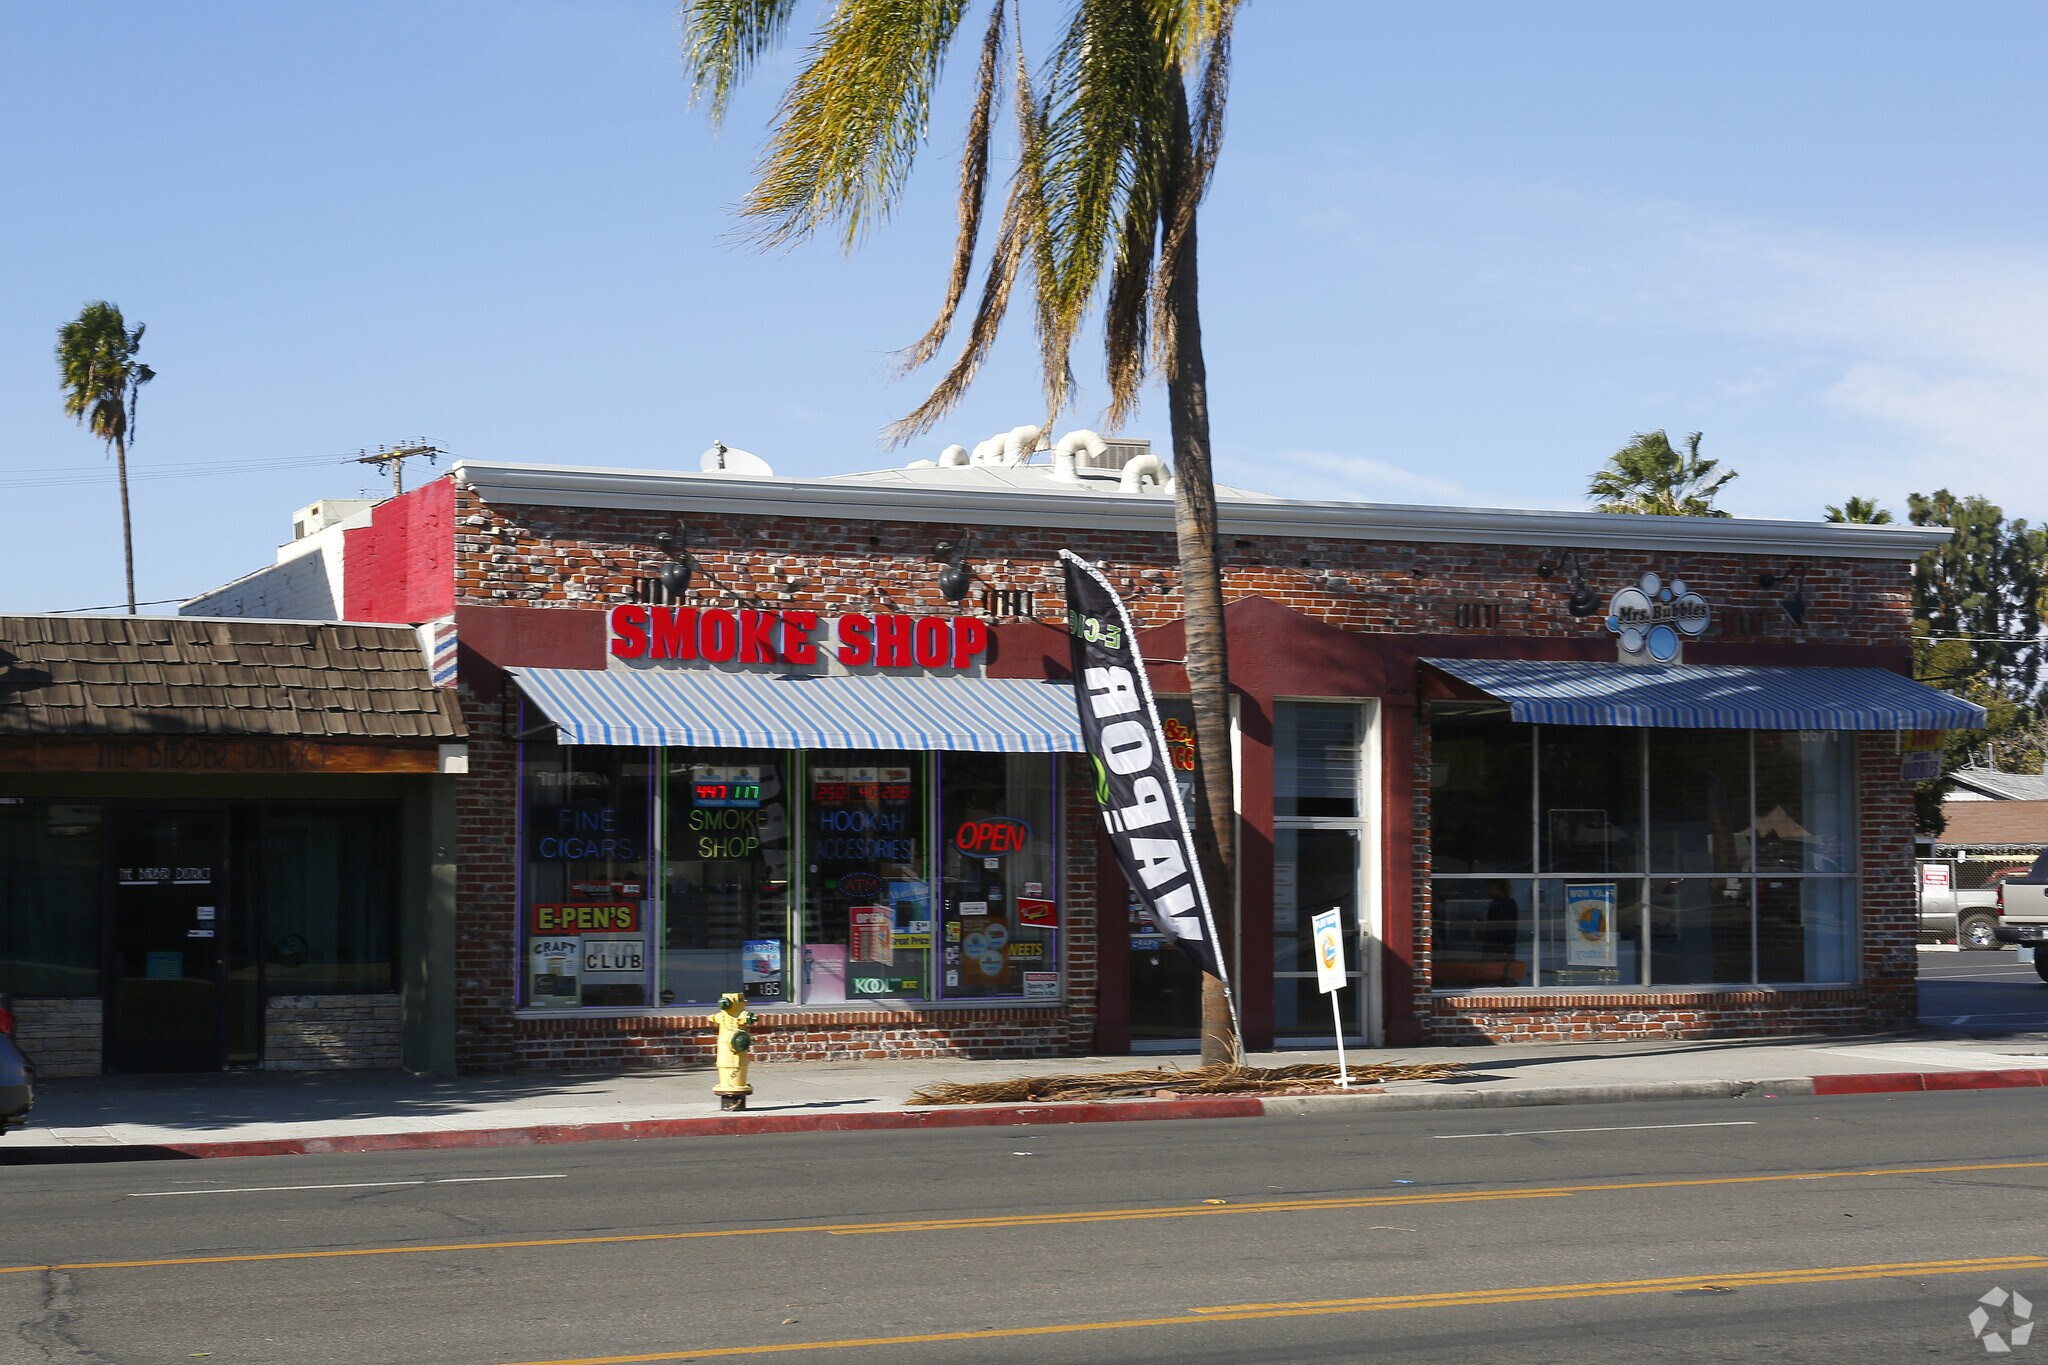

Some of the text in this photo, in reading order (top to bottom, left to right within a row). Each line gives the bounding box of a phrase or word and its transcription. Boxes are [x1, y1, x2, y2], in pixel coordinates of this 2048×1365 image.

[1619, 601, 1707, 622] Mrs. Bubbles
[609, 605, 988, 669] SMOKE SHOP
[97, 741, 329, 770] THE BARBER DISTRICT
[695, 785, 727, 799] 447
[558, 808, 616, 832] FINE
[688, 809, 769, 830] SMOKE
[820, 810, 905, 832] HOOKAH
[698, 836, 760, 858] SHOP
[956, 821, 1026, 852] OPEN
[540, 836, 634, 859] CIGARS
[119, 867, 212, 881] THE BARBER DISTRICT
[846, 879, 878, 893] ATM
[537, 906, 632, 930] E-PEN'S
[856, 913, 884, 924] OPEN
[534, 941, 577, 955] CRAFT
[892, 937, 910, 945] reat
[587, 955, 641, 969] CLUB
[855, 978, 893, 994] KOOL
